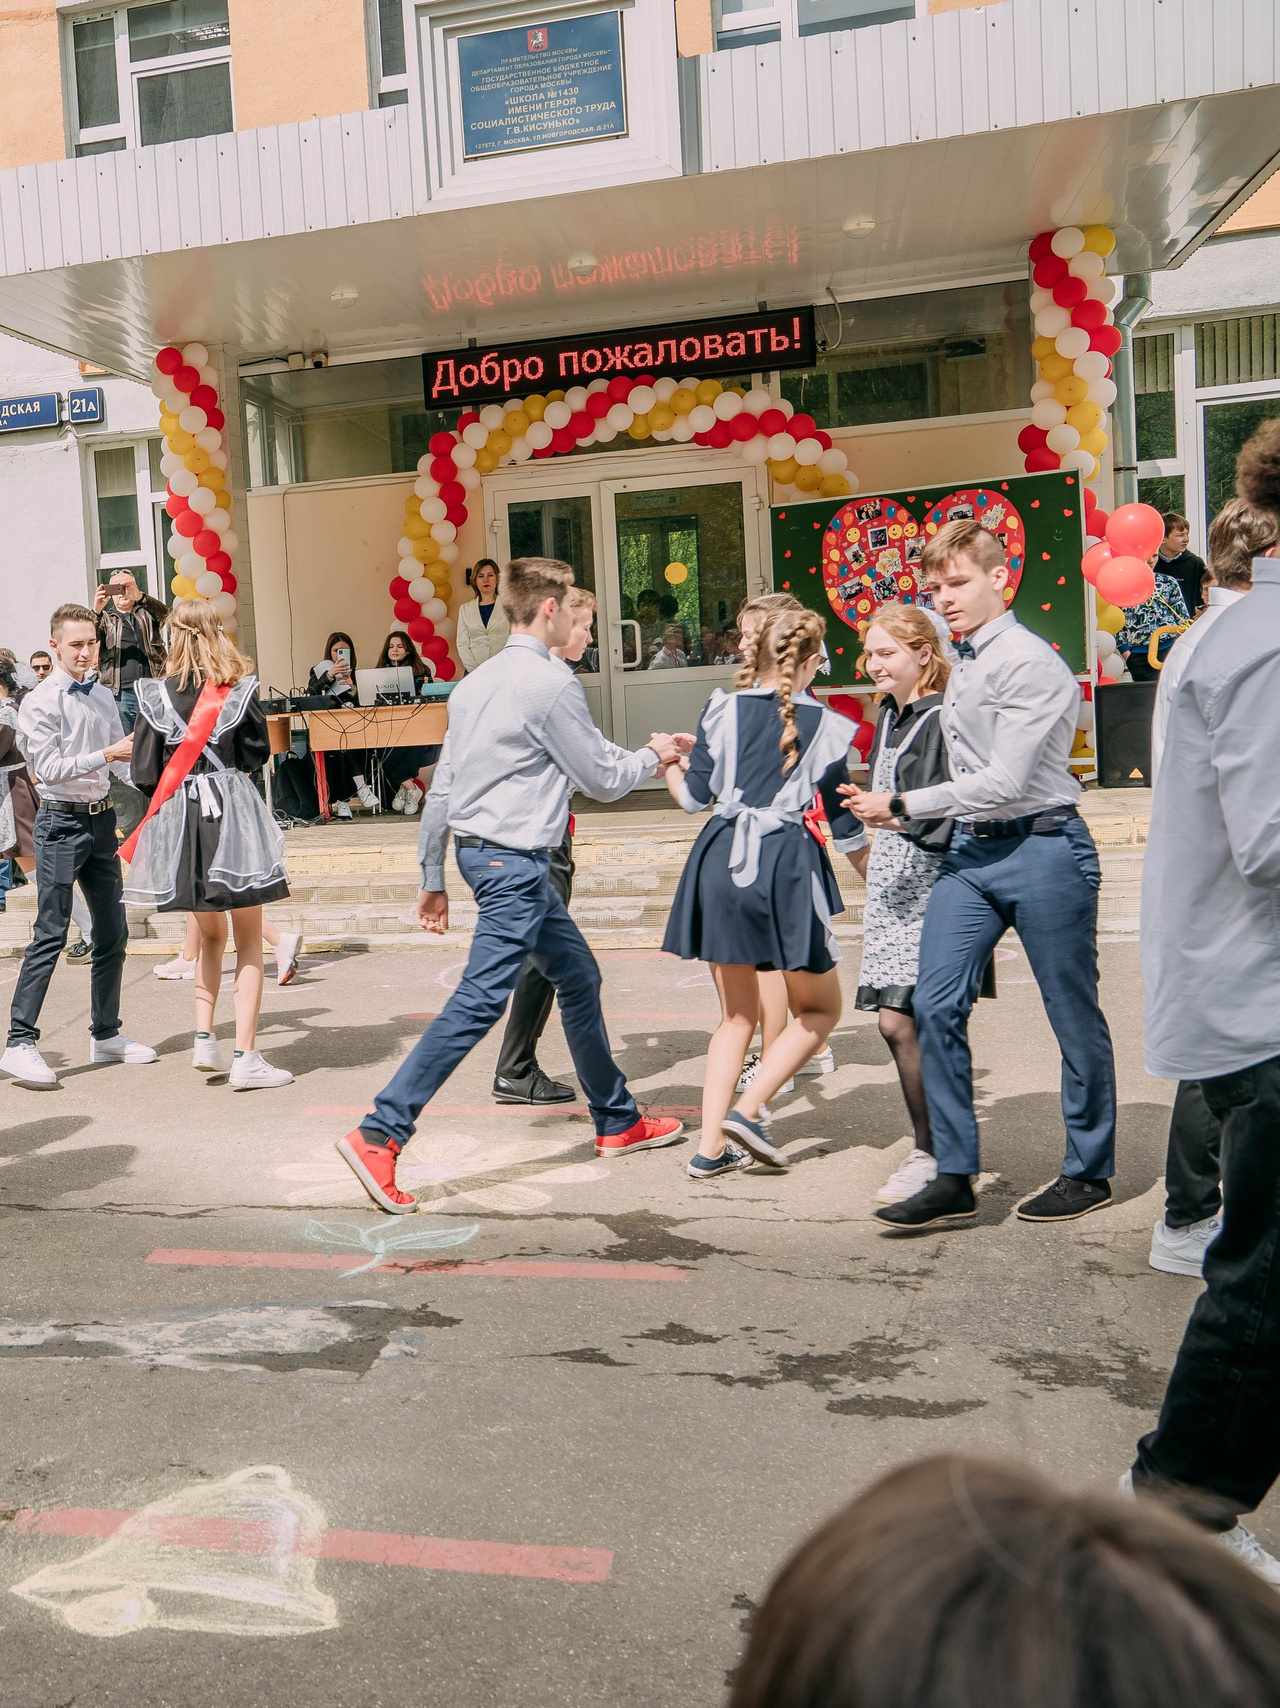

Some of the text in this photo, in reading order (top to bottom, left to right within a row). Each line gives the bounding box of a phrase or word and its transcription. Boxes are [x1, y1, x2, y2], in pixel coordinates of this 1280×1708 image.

[471, 65, 513, 77] ДЕПАРТАМЕНТ
[514, 58, 558, 70] ОБРАЗОВАНИЯ
[558, 53, 582, 62] ГОРОДА
[500, 47, 578, 64] ПРАВИТЕЛЬСТВО МОСКВЫ
[470, 63, 612, 92] ОБЩЕОБРАЗОВАТЕЛЬНОЕ УЧРЕЖДЕНИЕ
[481, 59, 599, 83] ГОСУДАРСТВЕННОЕ БЮДЖЕТНОЕ
[504, 86, 579, 105] «ШКОЛА №1430
[510, 78, 572, 93] ГОРОДА МОСКВЫ
[470, 101, 616, 130] СОЦИАЛИСТИЧЕСКОГО ТРУДА
[507, 97, 577, 115] ИМЕНИ ГЕРОЯ
[431, 316, 802, 399] Добро пожаловать!
[71, 398, 97, 414] 21А
